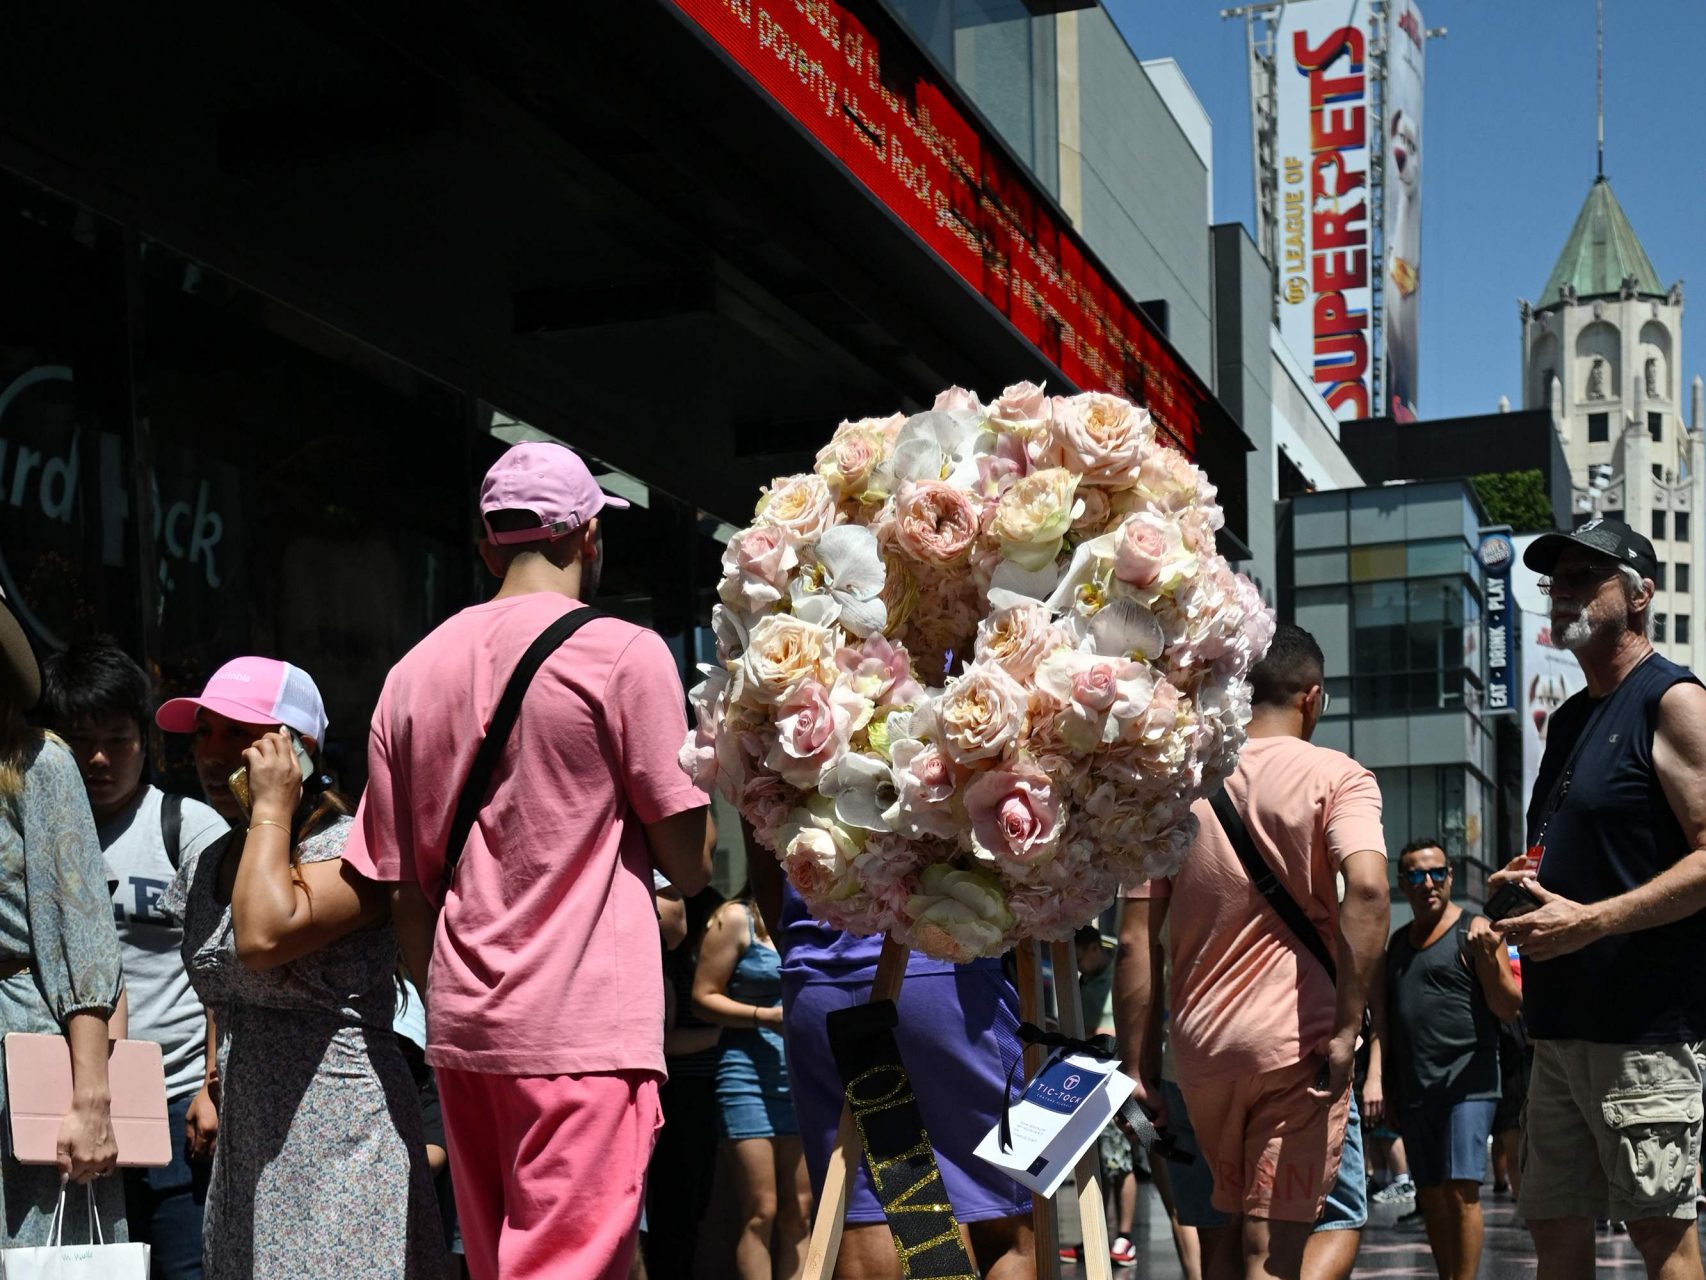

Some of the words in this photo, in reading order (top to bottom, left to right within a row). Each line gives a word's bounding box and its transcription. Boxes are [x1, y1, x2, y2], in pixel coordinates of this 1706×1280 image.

[891, 134, 931, 210] Rock
[1284, 156, 1303, 184] OF
[1284, 190, 1306, 273] LEAGUE
[1486, 577, 1506, 611] PLAY
[1488, 625, 1507, 668] DRINK
[1489, 683, 1508, 707] EAT
[1037, 1083, 1083, 1104] TIC-TOCK
